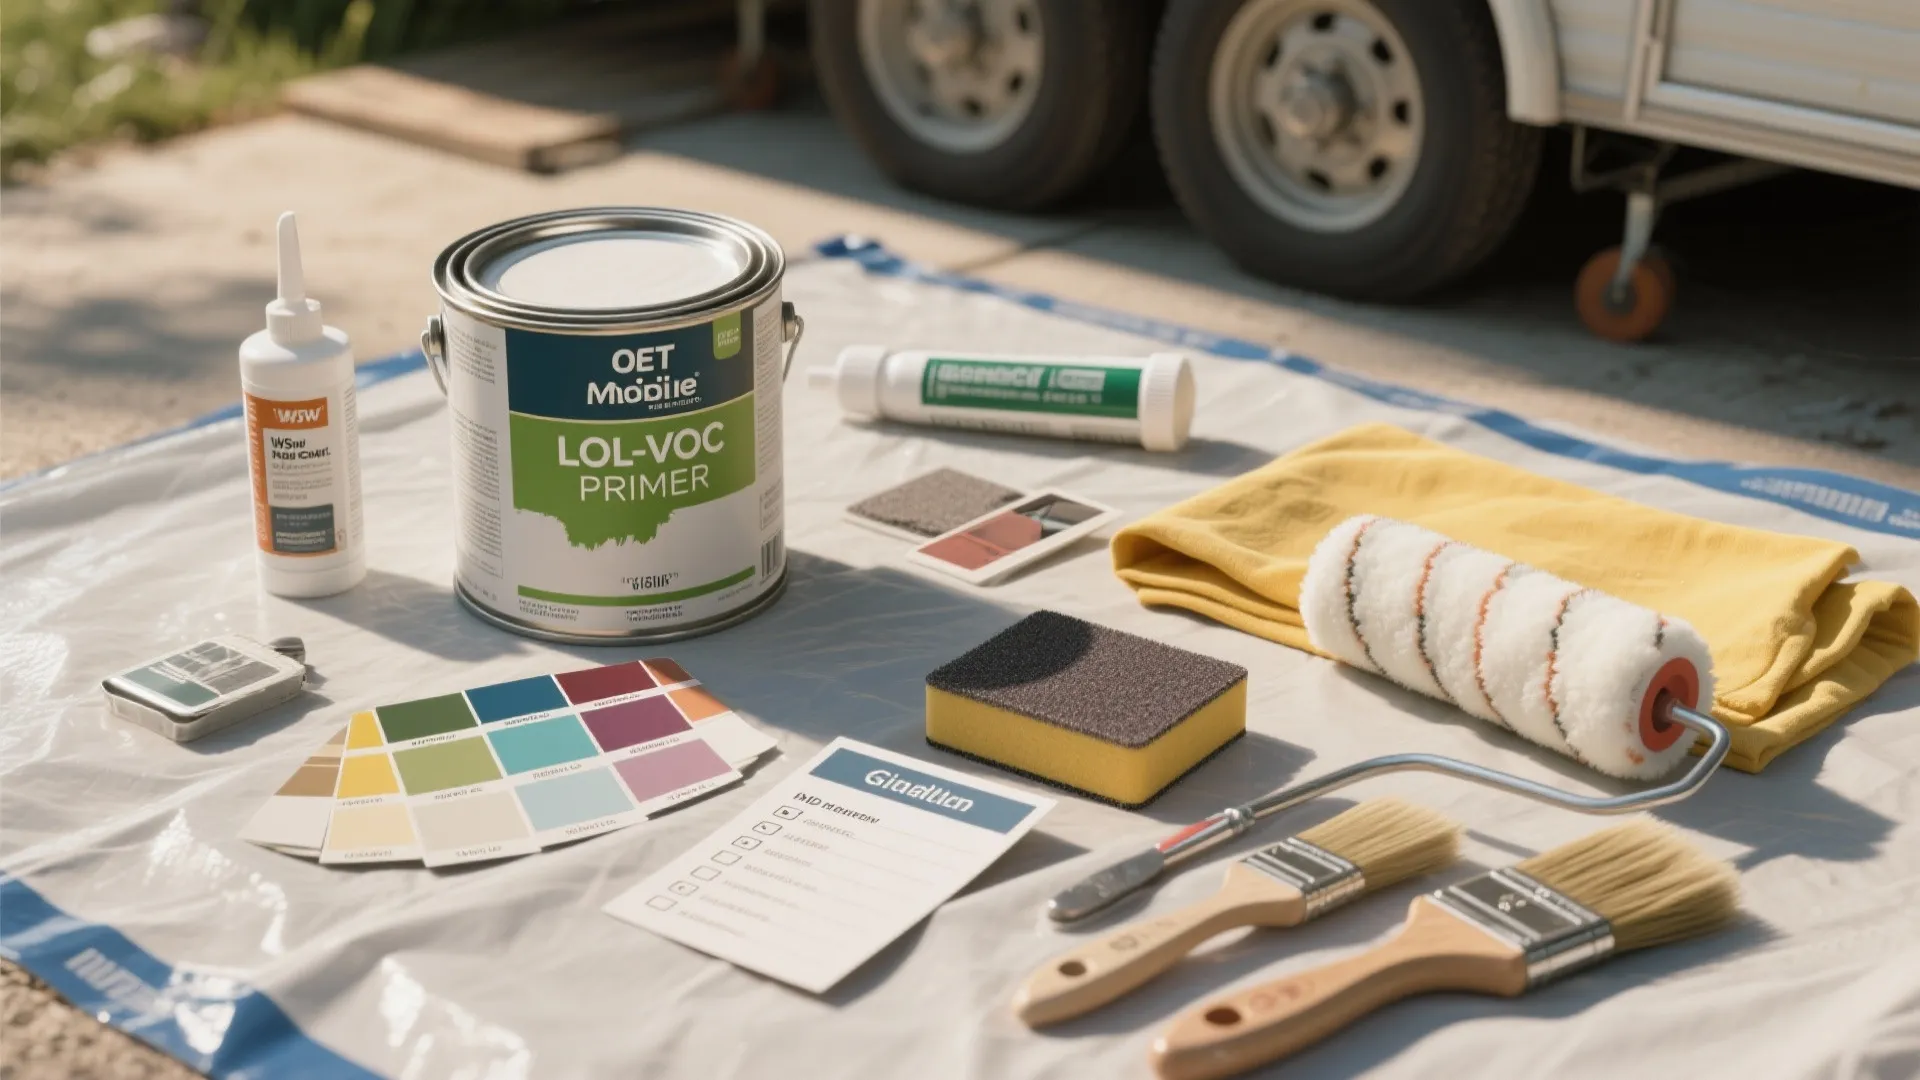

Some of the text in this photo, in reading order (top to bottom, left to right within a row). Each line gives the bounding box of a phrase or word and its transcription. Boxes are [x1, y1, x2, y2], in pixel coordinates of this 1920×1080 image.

[612, 344, 675, 374] OET
[558, 421, 725, 468] LOL-VOC
[581, 464, 709, 501] PRIMER
